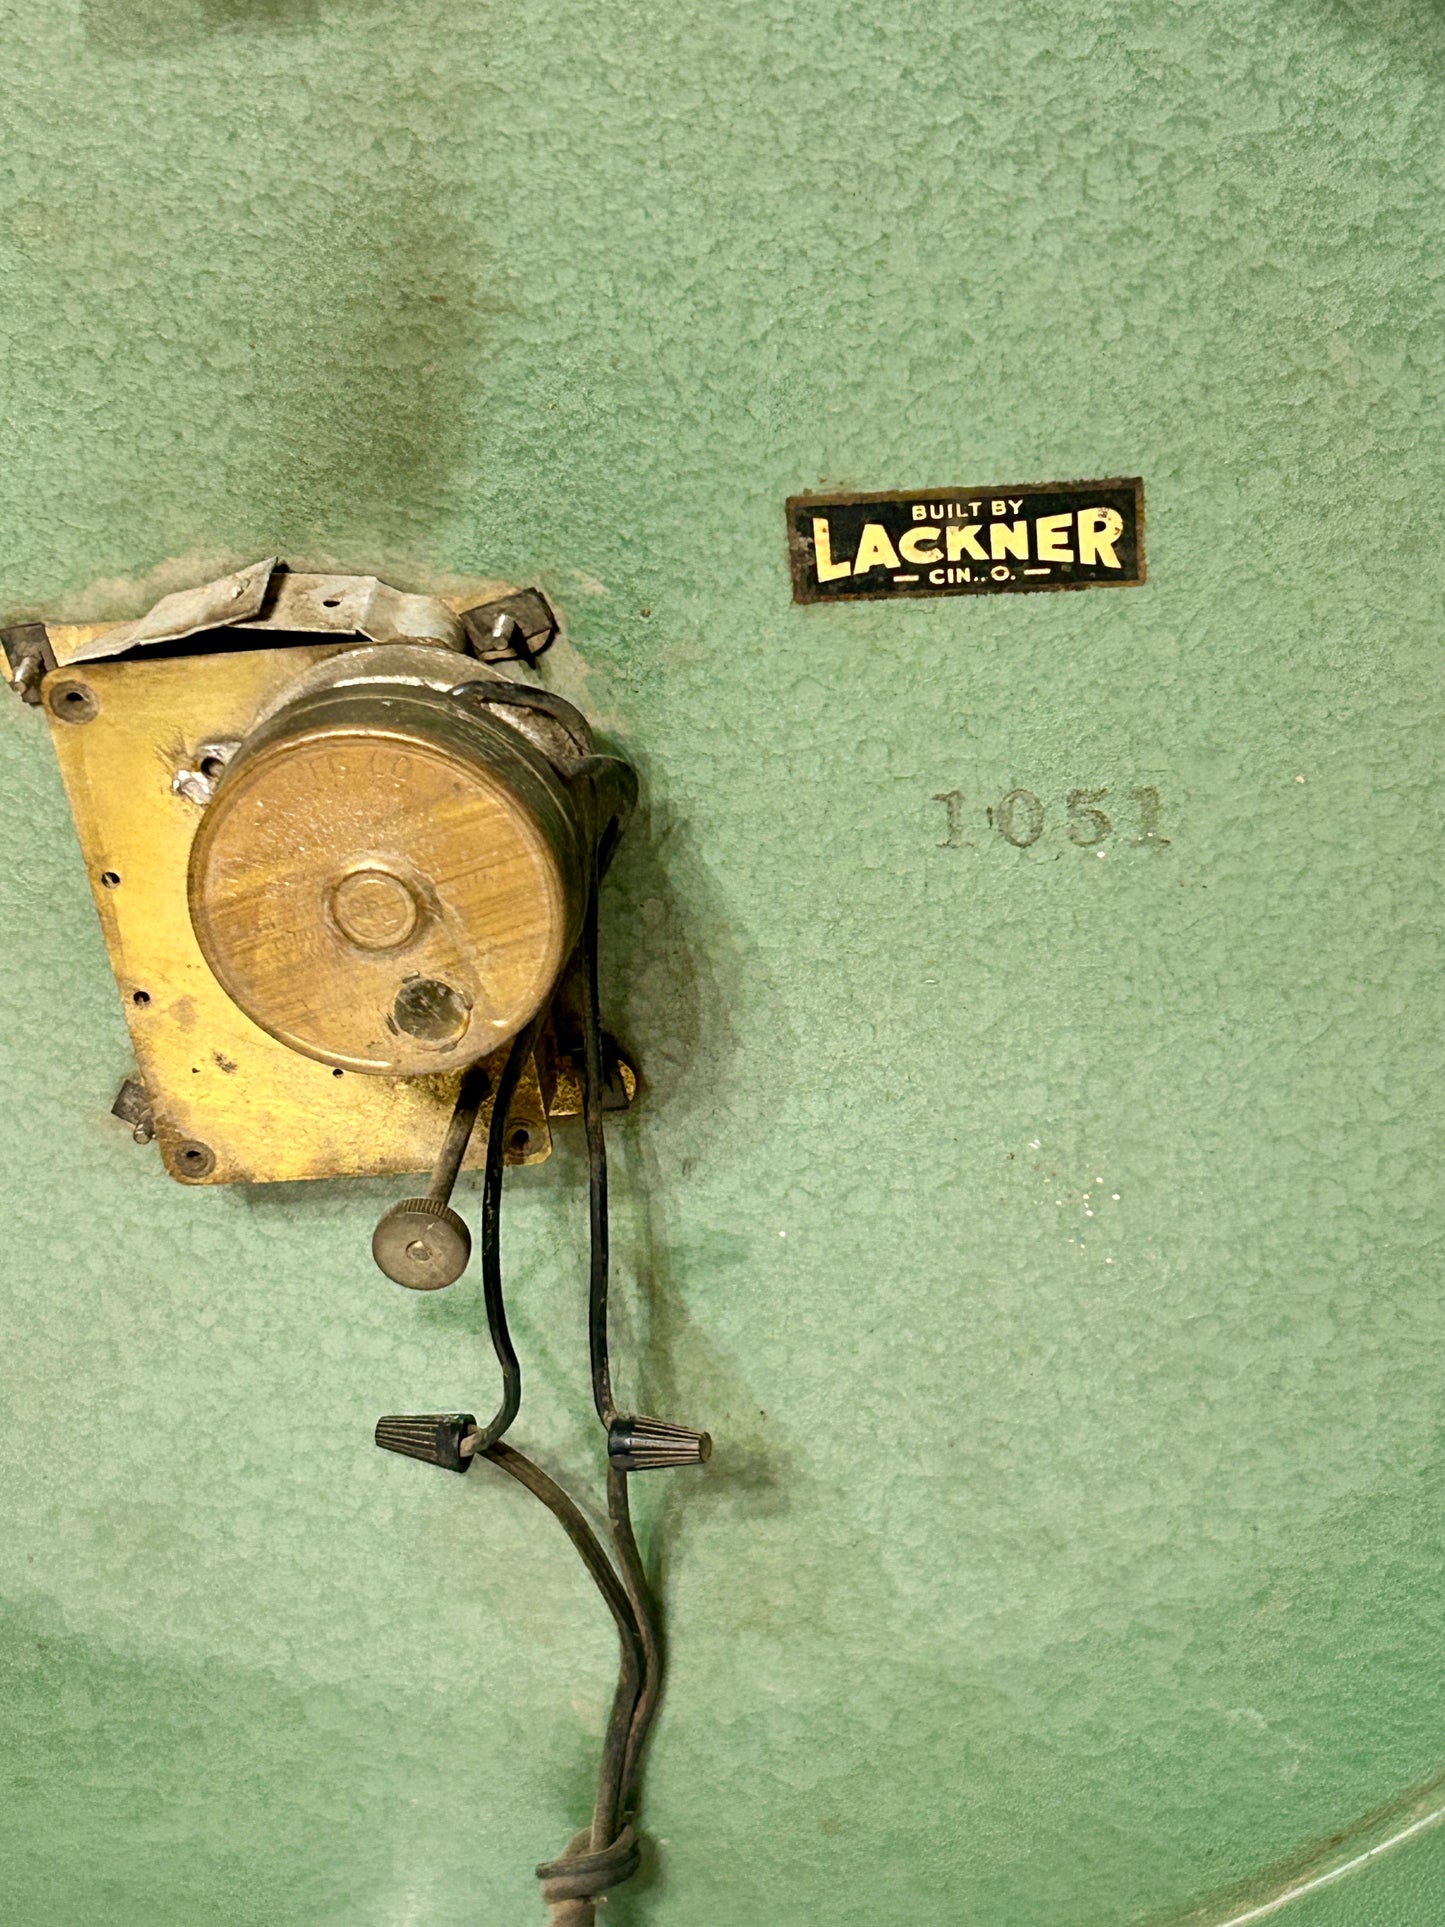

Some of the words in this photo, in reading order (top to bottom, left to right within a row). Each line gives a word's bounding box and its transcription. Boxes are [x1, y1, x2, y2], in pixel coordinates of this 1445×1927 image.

[912, 502, 979, 521] BUILT
[990, 499, 1024, 516] BY
[812, 507, 1123, 583] LACKNER
[930, 787, 1171, 849] 1051
